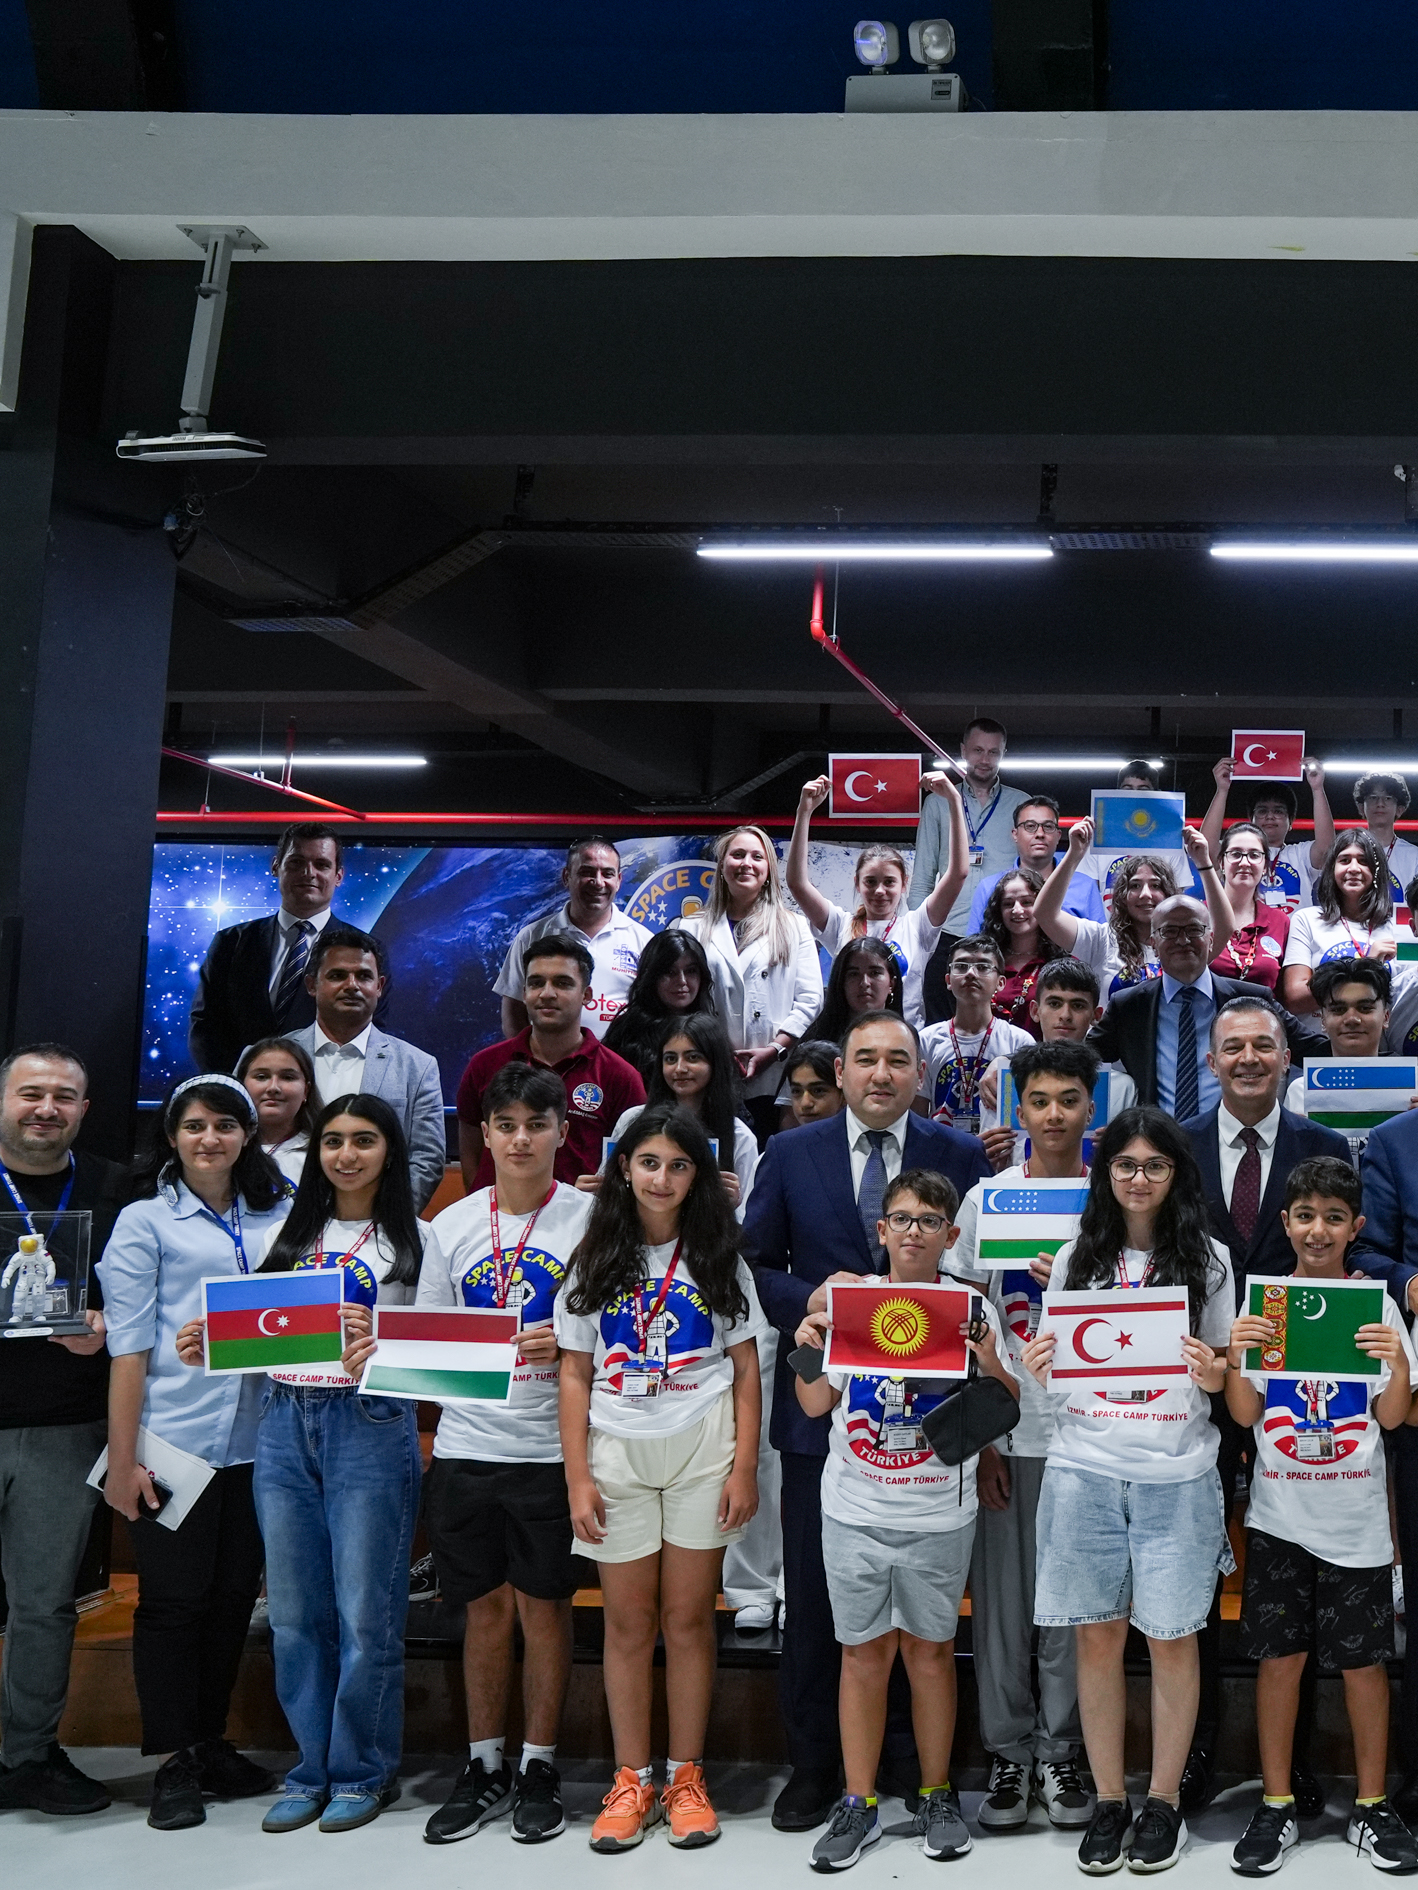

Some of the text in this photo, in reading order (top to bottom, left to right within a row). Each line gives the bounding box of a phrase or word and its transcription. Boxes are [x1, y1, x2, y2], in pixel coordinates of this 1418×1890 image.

[1109, 857, 1128, 874] SPAC
[631, 869, 690, 923] SPACE
[1327, 941, 1355, 958] SPAC
[938, 1058, 968, 1085] SPACE
[293, 1253, 372, 1289] ACE CAMP
[466, 1250, 515, 1287] SPAE
[272, 1373, 360, 1385] SPACE CAMP TÜRKİY
[512, 1374, 532, 1382] AMP
[1092, 1410, 1120, 1419] SPACE
[1123, 1411, 1149, 1420] CAMP
[859, 1446, 921, 1466] TÜRKİYE
[885, 1476, 911, 1485] CAMP
[1286, 1471, 1313, 1480] SPACE
[1314, 1472, 1339, 1480] CAMP
